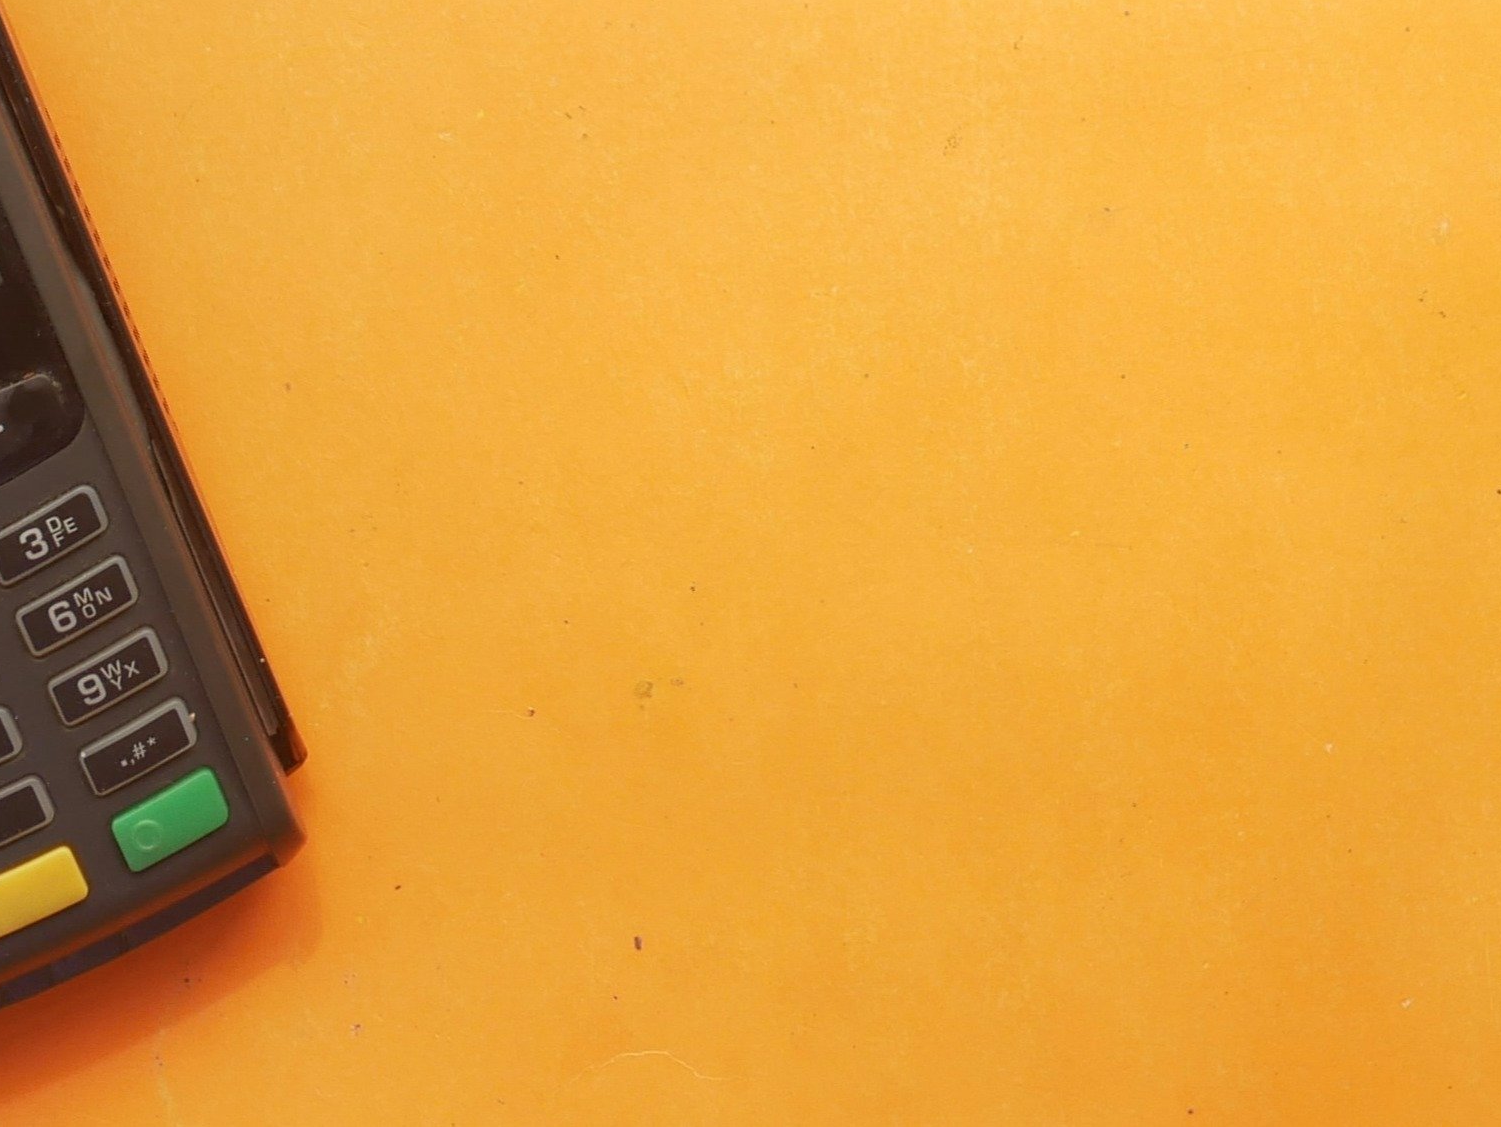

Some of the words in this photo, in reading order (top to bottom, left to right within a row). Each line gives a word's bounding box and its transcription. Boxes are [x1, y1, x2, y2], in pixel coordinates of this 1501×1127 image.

[18, 527, 49, 561] 3
[47, 600, 78, 633] 6
[76, 672, 107, 706] 9
